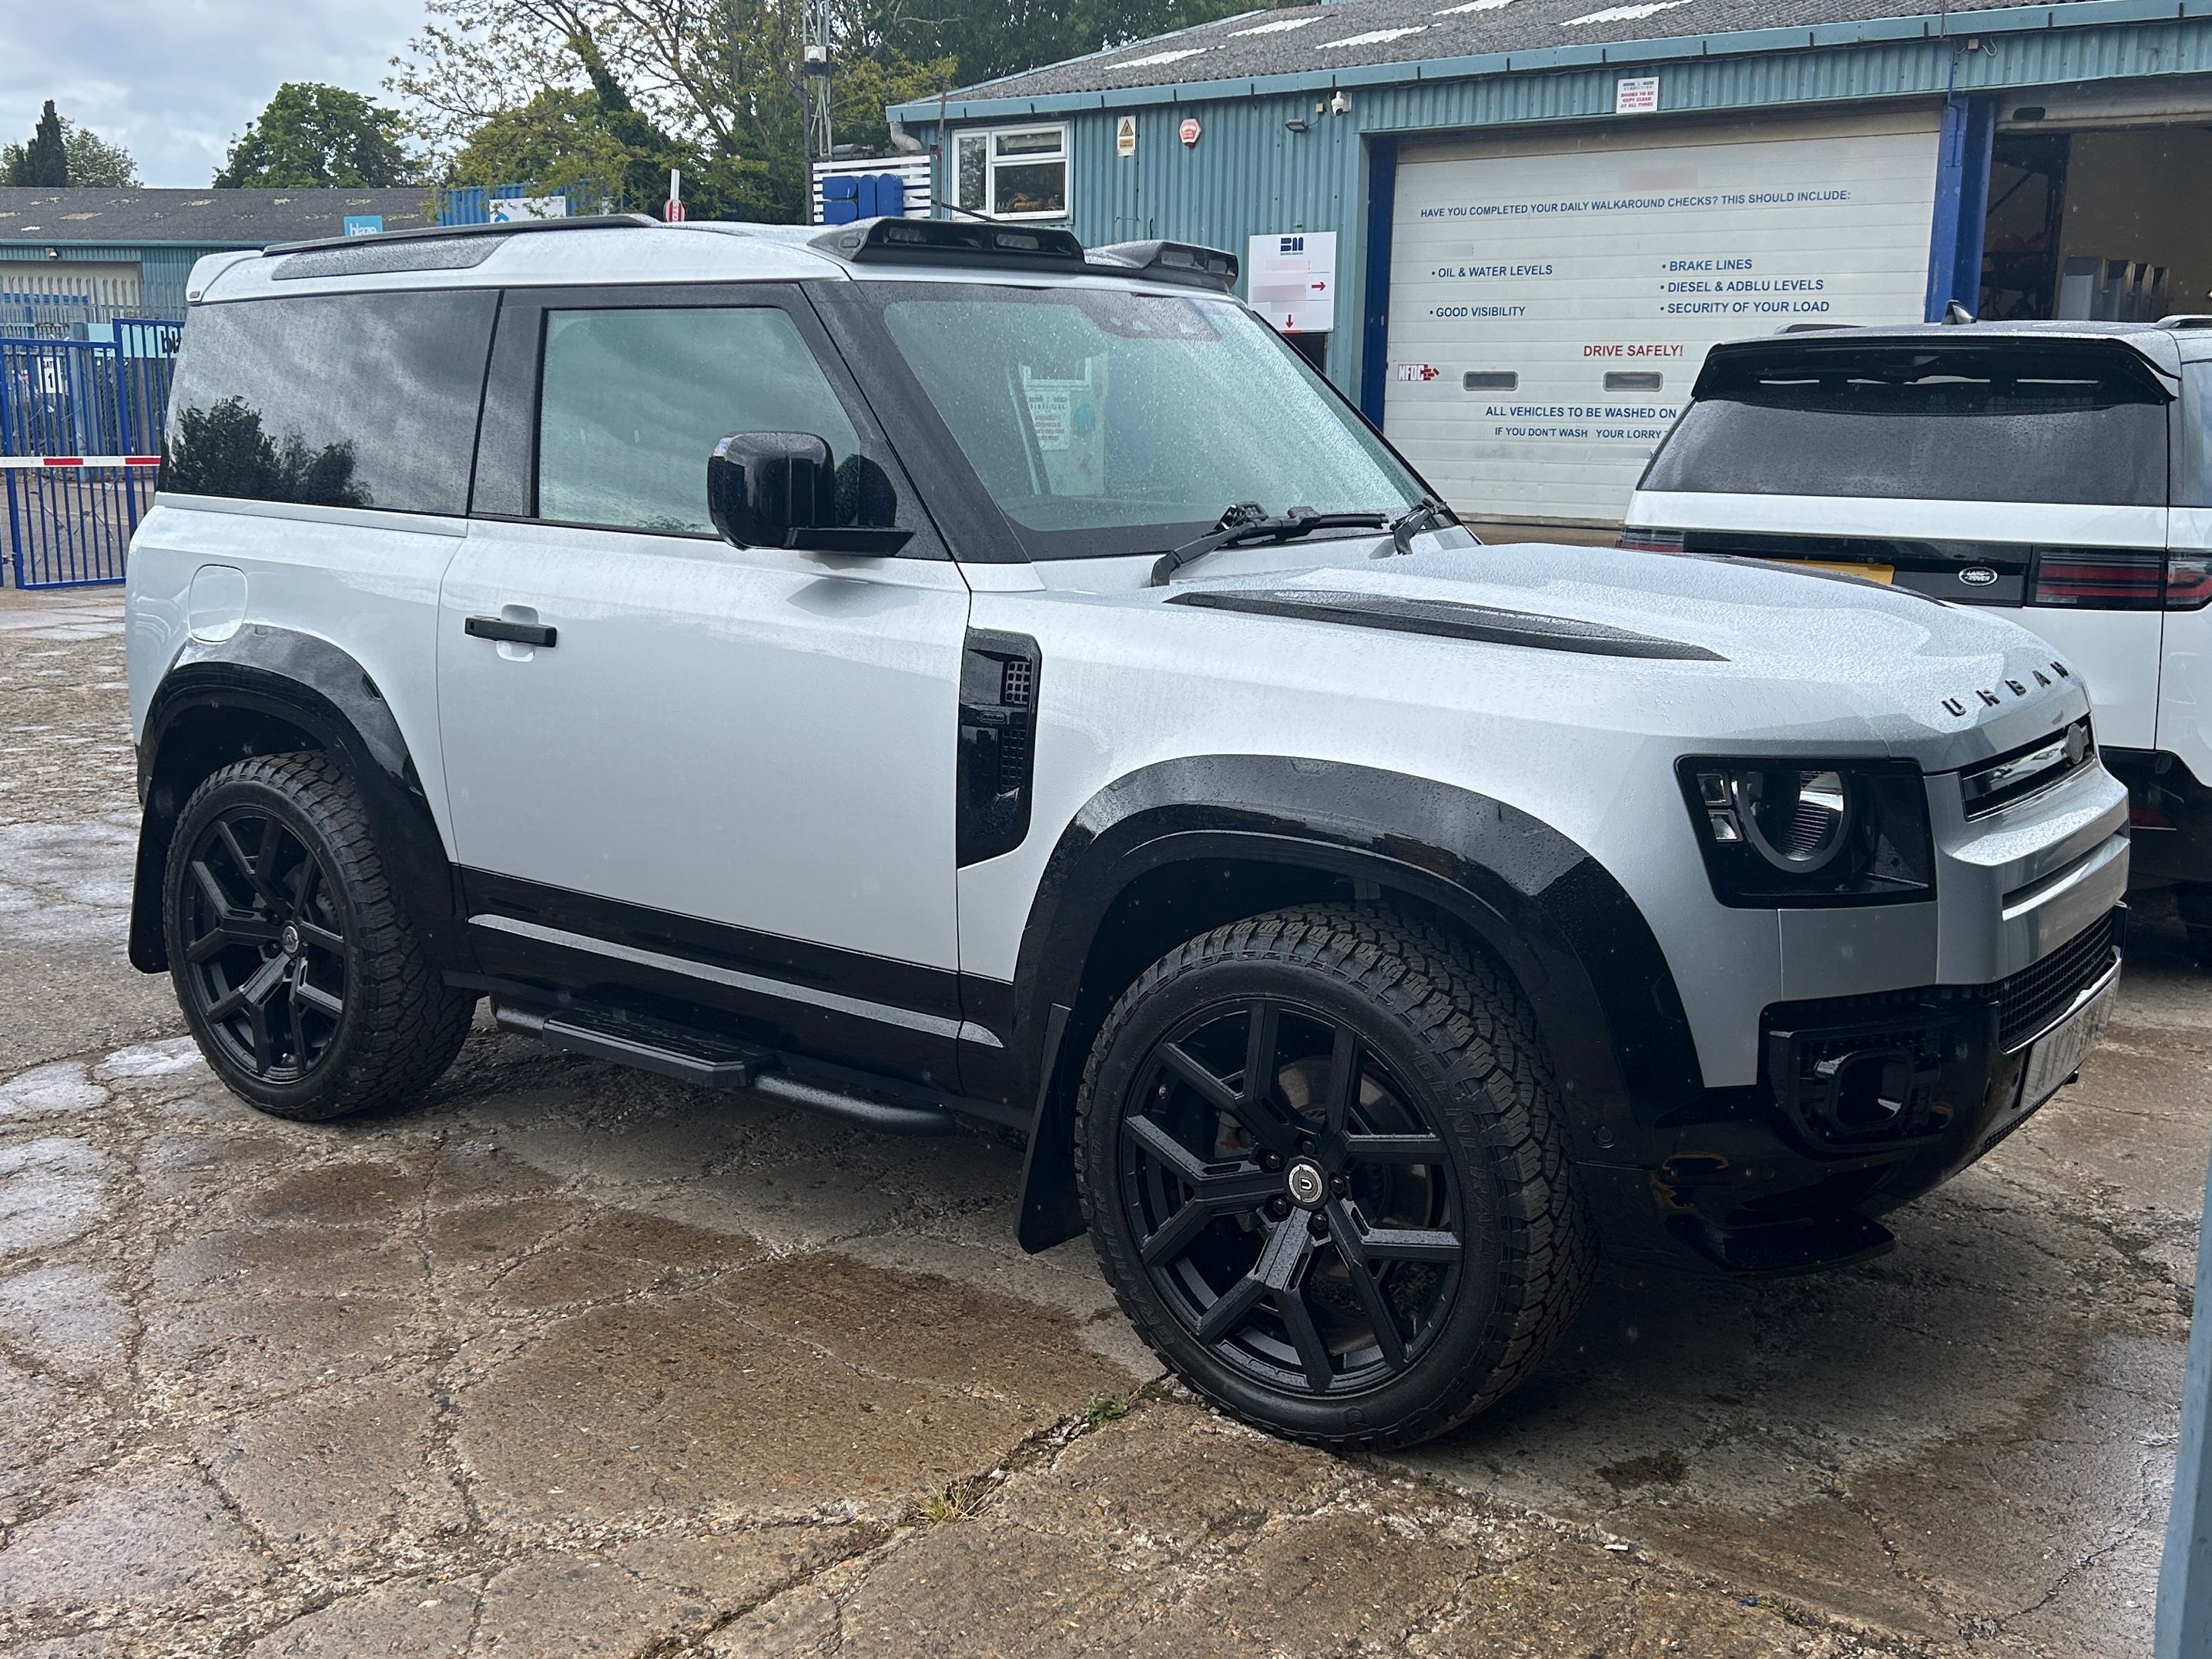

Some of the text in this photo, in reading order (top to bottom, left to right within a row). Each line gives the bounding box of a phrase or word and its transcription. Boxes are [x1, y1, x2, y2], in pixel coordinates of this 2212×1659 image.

[1421, 189, 1852, 218] HAVE YOU COMPLETED YOUR DAILY WALKAROUND CHECKS? THIS SHOULD INCLUDE:
[1438, 264, 1553, 278] OIL & WATER LEVELS
[1669, 259, 1753, 272] BRAKE LINES
[1667, 279, 1824, 293] DIESEL & ADBLU LEVELS
[1436, 306, 1527, 317] GOOD VISIBILITY
[1667, 301, 1830, 313] SECURITY OF YOUR LOAD
[1584, 344, 1684, 357] DRIVE SAFELY!
[1398, 364, 1425, 380] NFDC
[48, 373, 53, 388] 1
[1485, 406, 1677, 419] ALL VEHICLES TO BE WASHED ON
[1495, 427, 1503, 436] IF
[1506, 427, 1527, 437] YOU
[1528, 427, 1557, 437] DON'T
[1559, 428, 1588, 438] WASH
[1596, 428, 1624, 439] YOUR
[1627, 429, 1662, 440] LORRY
[1941, 661, 2070, 717] URBAN
